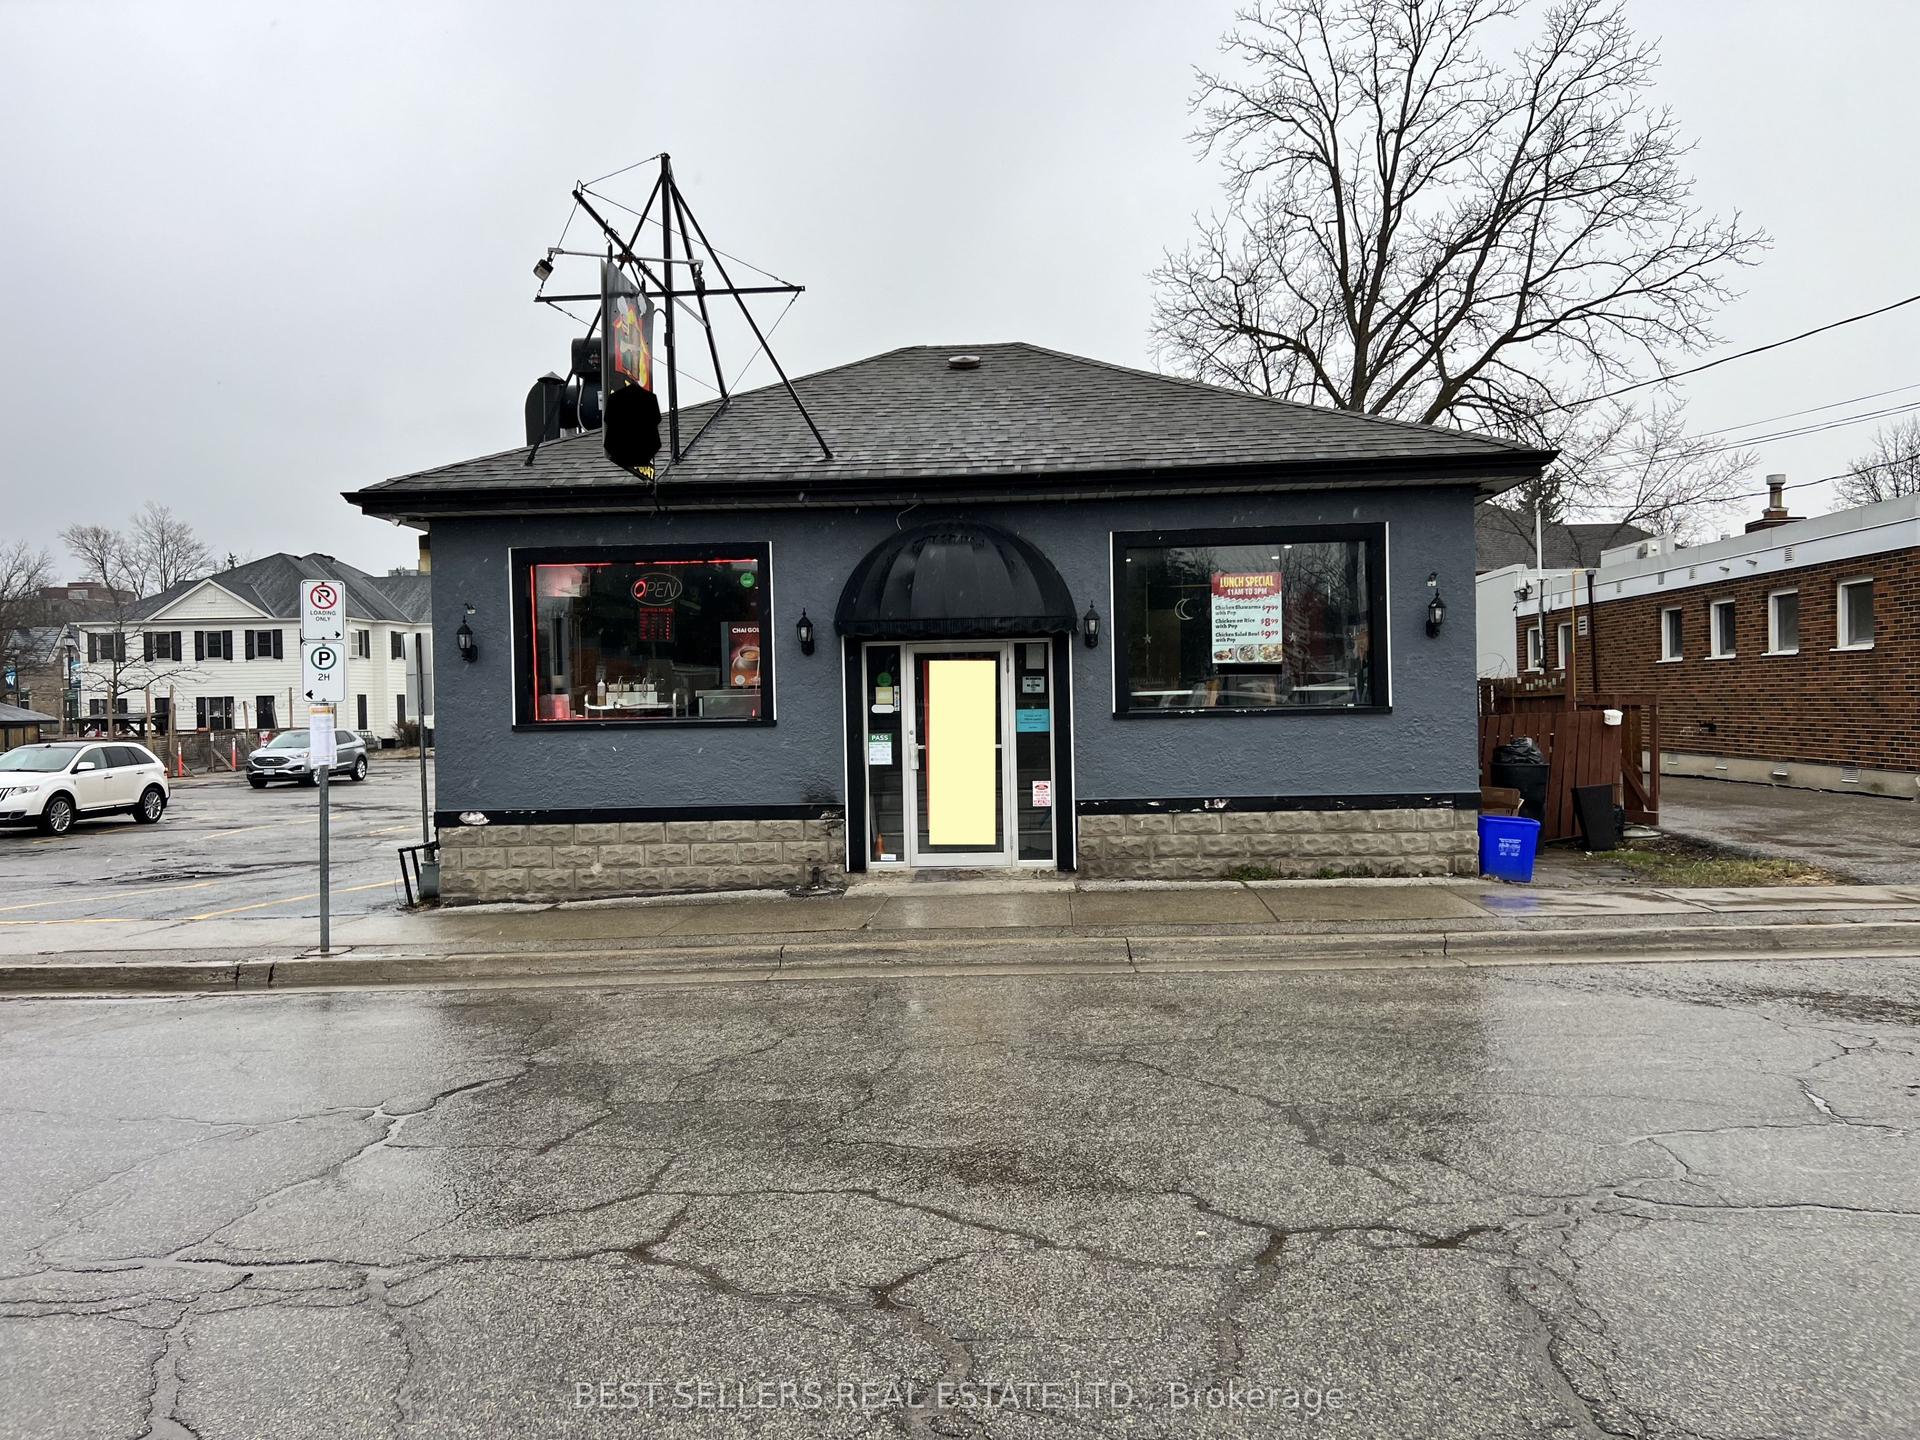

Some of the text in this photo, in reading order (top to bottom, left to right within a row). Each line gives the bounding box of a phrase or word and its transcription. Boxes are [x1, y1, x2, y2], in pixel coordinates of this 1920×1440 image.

[1220, 575, 1274, 588] LUNCH SPECIAL
[633, 580, 678, 598] OPEN
[317, 673, 330, 681] 2H
